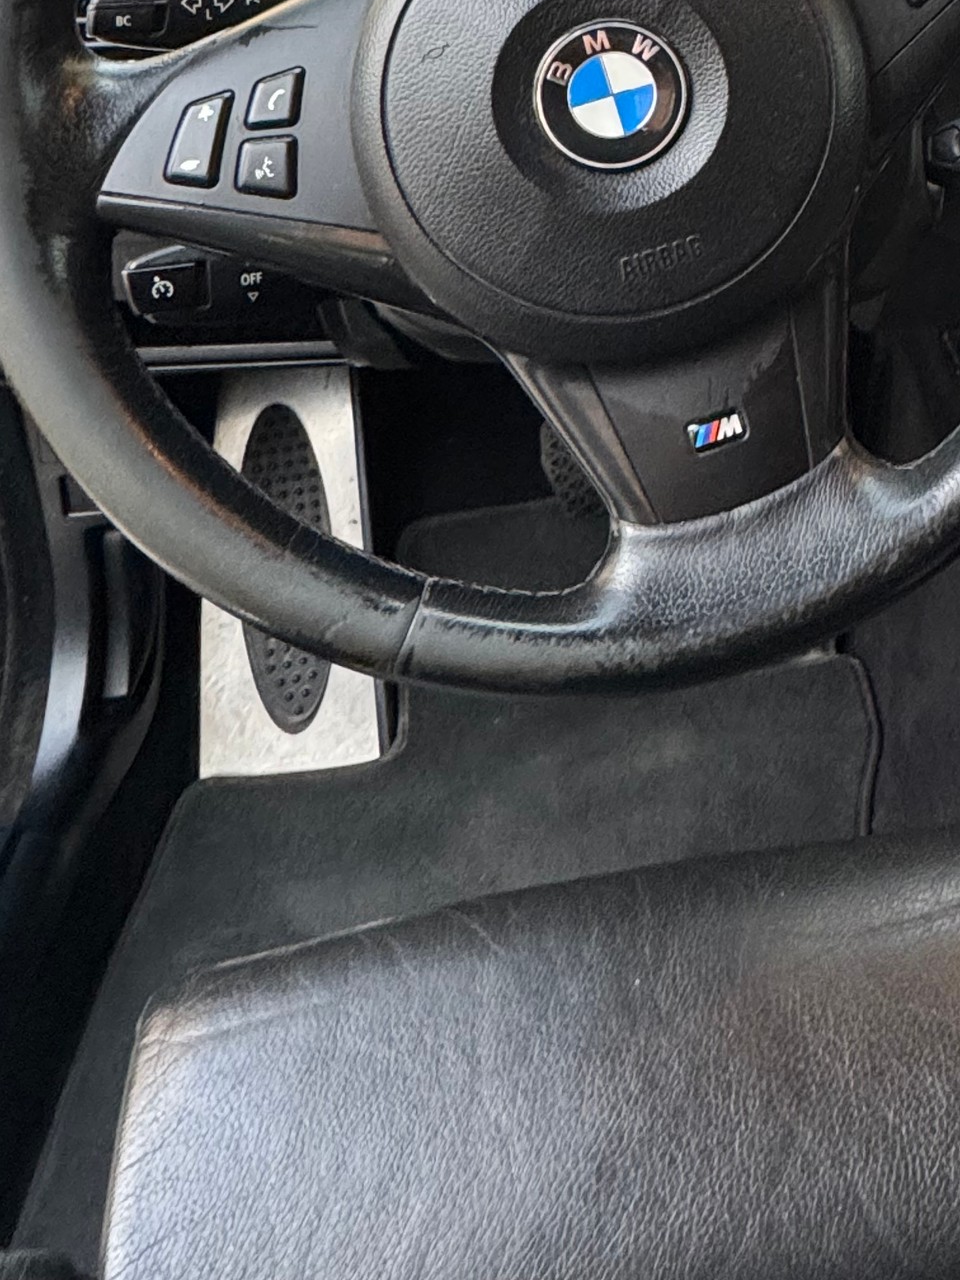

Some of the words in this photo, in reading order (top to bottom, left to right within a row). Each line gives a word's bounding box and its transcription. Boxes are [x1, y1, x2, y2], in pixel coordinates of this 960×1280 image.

[115, 15, 132, 28] BC
[205, 8, 213, 21] L
[546, 29, 661, 87] BMW
[240, 271, 263, 287] OFF
